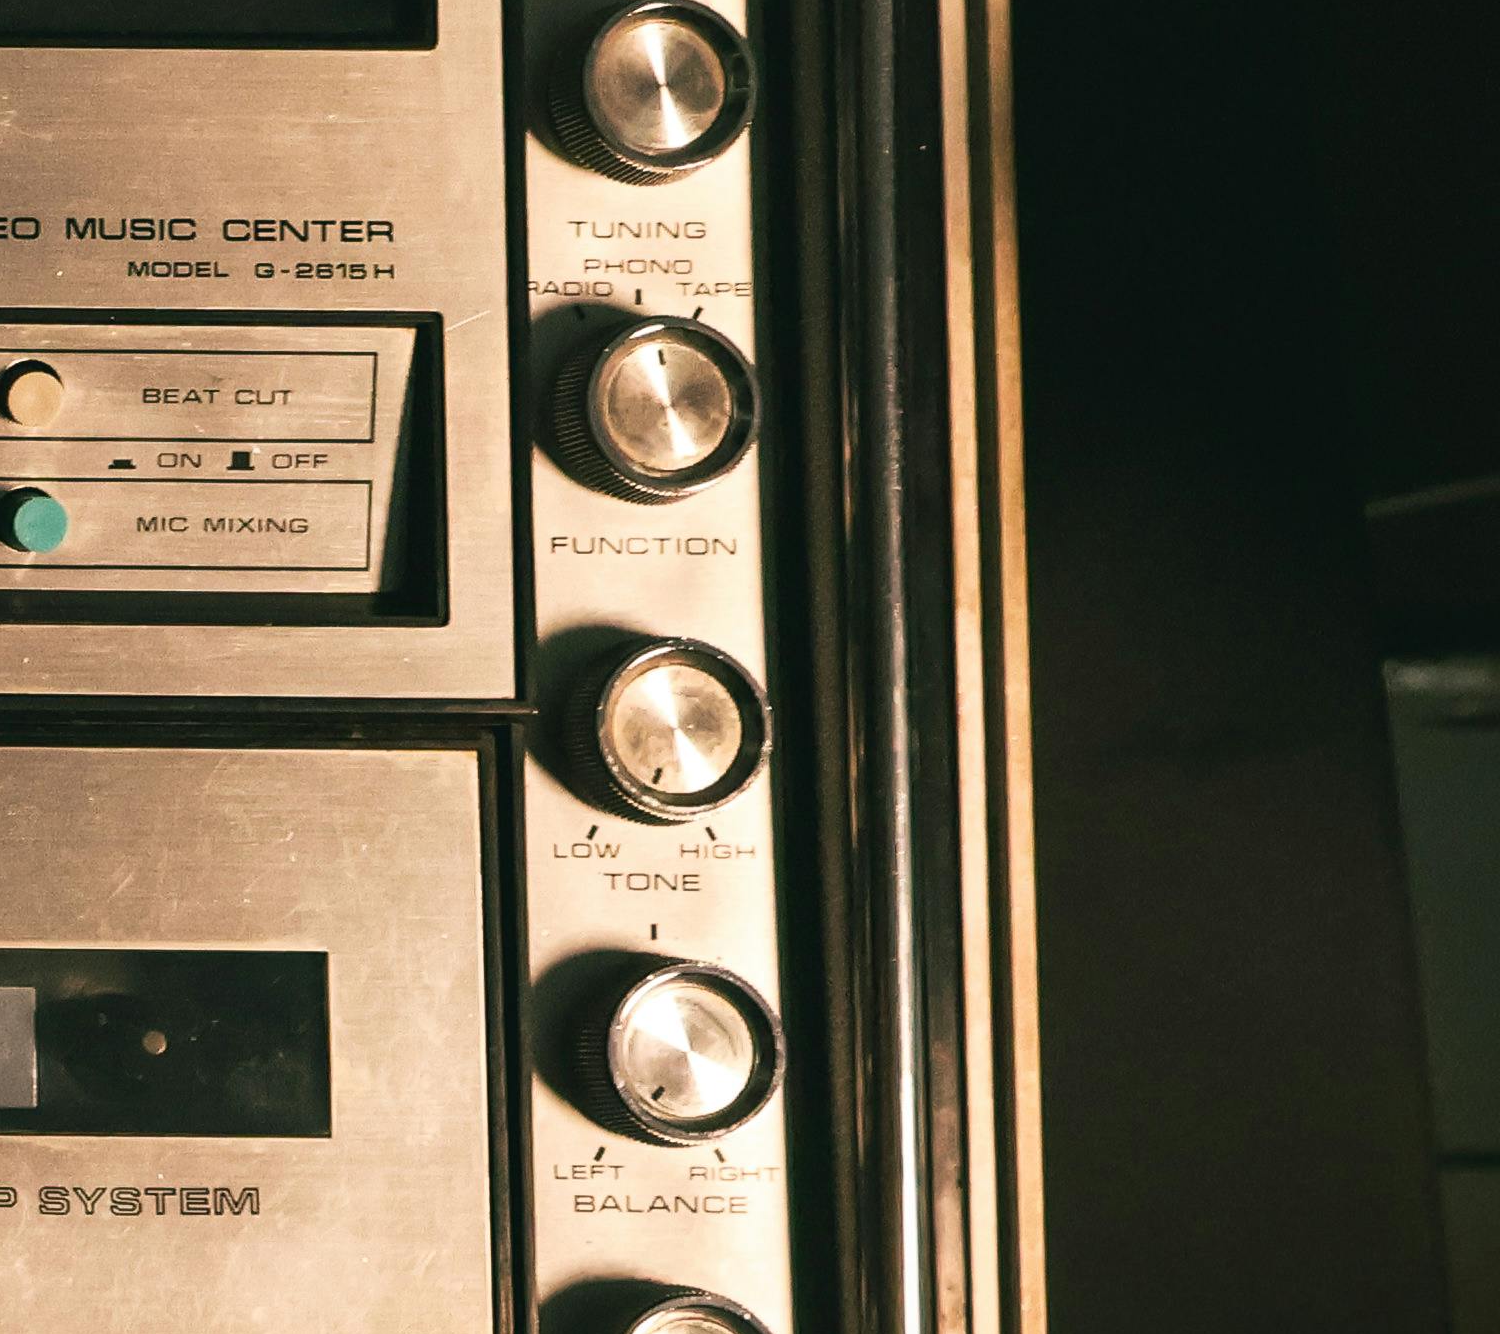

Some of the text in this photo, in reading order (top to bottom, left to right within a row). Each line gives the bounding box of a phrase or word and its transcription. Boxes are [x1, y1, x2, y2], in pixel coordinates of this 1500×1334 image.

[65, 217, 198, 243] MUSIC
[222, 218, 395, 244] CENTER
[567, 220, 707, 239] TUNING
[127, 261, 229, 278] MODEL
[583, 258, 693, 275] PHONO
[527, 280, 614, 297] RADIO
[675, 281, 752, 298] TAPE
[142, 387, 293, 406] BEAT CUT
[156, 452, 202, 468] ON
[271, 453, 329, 469] OFF
[136, 516, 310, 534] MIC MIXING
[551, 536, 738, 556] FUNCTION
[553, 842, 622, 859] LOW
[679, 843, 756, 860] HIGH
[603, 872, 703, 892] TONE
[554, 1164, 625, 1181] LEFT
[689, 1165, 780, 1182] RIGHT
[38, 1185, 260, 1217] SYSTEM
[574, 1194, 750, 1214] BALANCE
